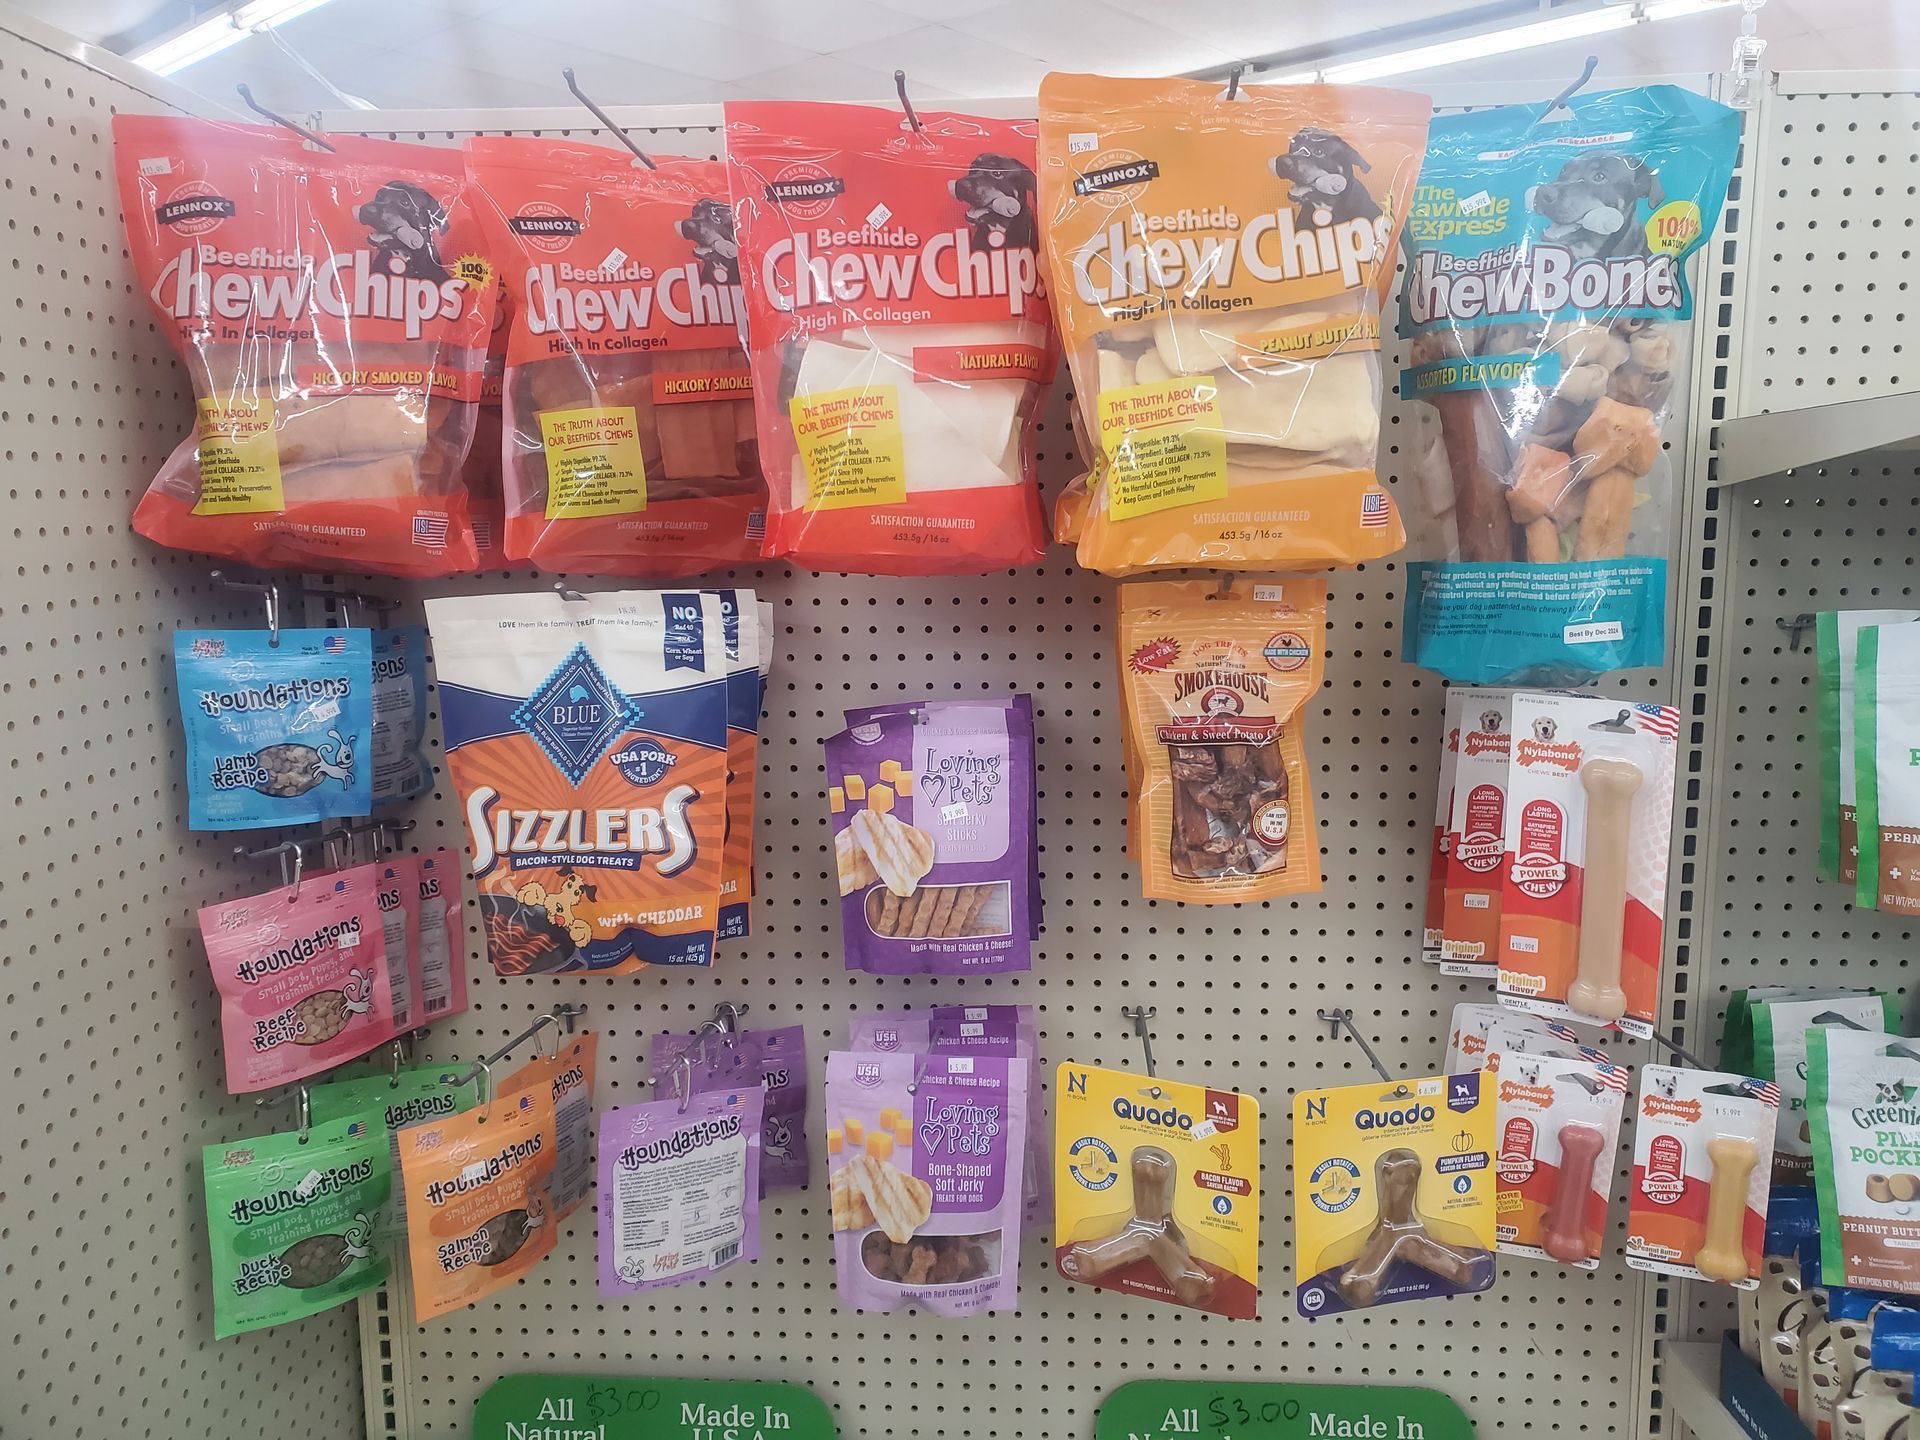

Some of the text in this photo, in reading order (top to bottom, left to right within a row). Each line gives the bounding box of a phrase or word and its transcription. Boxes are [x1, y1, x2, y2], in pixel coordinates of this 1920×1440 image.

[1069, 141, 1091, 152] $15.99
[776, 182, 835, 197] LENNOX
[1418, 185, 1456, 201] The
[519, 221, 573, 231] LENNOX
[1132, 205, 1240, 235] Beefhide
[1409, 215, 1507, 241] Express
[816, 226, 920, 248] Beefhide
[201, 244, 315, 269] Beefhide
[1073, 208, 1393, 307] Chew Chips
[762, 232, 918, 312] Chew
[151, 248, 469, 340] Chew Chips
[1113, 295, 1253, 321] High In Collagen
[549, 336, 668, 353] High In Collagen
[1259, 322, 1364, 353] PEANUT BUTTER
[803, 396, 884, 419] THE TRUTH ABOUT
[553, 417, 624, 433] THE TRUTH ABOUT
[1169, 466, 1180, 474] 1990
[1122, 486, 1130, 494] No
[1130, 482, 1151, 492] Harmful
[1153, 477, 1176, 488] Chemicals
[1183, 471, 1216, 482] Preservatives
[870, 514, 975, 529] SATISFACTION GUARANTEED
[1193, 510, 1310, 524] SATISFACTION GUARANTEED
[253, 521, 367, 537] SATISFACTION GUARANTEED
[617, 521, 708, 530] SATISFACTION GUARANTEED
[672, 607, 698, 620] NO
[1137, 644, 1173, 666] Low Fat
[1174, 670, 1270, 703] SMOKEHOUSE
[201, 677, 351, 716] Houndations
[552, 704, 601, 726] BLUE
[1191, 729, 1199, 741] &
[1202, 730, 1231, 741] Sweet
[1234, 729, 1264, 742] Potato
[1471, 737, 1510, 749] Nylabon
[610, 750, 677, 765] USA PORK
[1523, 746, 1575, 760] Nylabone
[215, 753, 257, 771] Lamb
[925, 747, 1001, 783] Loving
[212, 768, 268, 789] Recipe
[948, 774, 993, 805] Pets
[1527, 810, 1557, 819] LASTING
[465, 784, 701, 880] SIZZLERS
[947, 828, 977, 841] Sticks
[1464, 844, 1499, 856] POWER
[516, 855, 634, 867] BACON-STYLE DOG TREATS
[1467, 856, 1497, 868] CHEW
[1520, 870, 1558, 878] POWER
[1524, 881, 1557, 892] CHEW
[598, 905, 703, 928] with CHEDDAR
[236, 915, 362, 983] Houndations
[1445, 943, 1482, 955] Original
[1500, 973, 1543, 989] Original
[1509, 984, 1535, 995] flavor
[1505, 999, 1528, 1007] GENTLE
[255, 1009, 296, 1035] Beef
[1618, 1020, 1647, 1032] EXTREME
[253, 1020, 305, 1051] Recipe
[875, 1032, 898, 1043] USA
[857, 1066, 880, 1076] USA
[922, 1076, 1001, 1088] Chicken & Cheese Recipe
[1505, 1085, 1549, 1100] Nylabone
[1113, 1098, 1192, 1130] Quado
[1649, 1100, 1695, 1114] Nylabone
[924, 1096, 1000, 1137] Loving
[1355, 1105, 1435, 1130] Quado
[1509, 1124, 1531, 1132] LASTING
[620, 1114, 741, 1172] Houndations
[946, 1122, 991, 1155] Pets
[1655, 1142, 1678, 1150] LASTING
[1441, 1154, 1484, 1166] PUMPKIN FLAVOR
[1501, 1163, 1529, 1171] POWER
[928, 1162, 992, 1178] Bone-Shaped
[1503, 1172, 1527, 1180] CHEW
[935, 1177, 984, 1194] Soft Jerky
[1201, 1173, 1244, 1187] BACON FLAVOR
[1648, 1183, 1678, 1191] POWER
[936, 1194, 983, 1203] TREATS FOR DOGS
[1651, 1193, 1677, 1201] CHEW
[1496, 1226, 1517, 1236] acon
[1843, 1223, 1920, 1237] PEANUT BUTT
[437, 1228, 489, 1260] Salmon
[1638, 1245, 1680, 1258] Peanut Butter
[240, 1254, 280, 1278] Duck
[440, 1241, 491, 1275] Recipe
[234, 1264, 292, 1295] Recipe
[1307, 1296, 1321, 1304] USA
[537, 1398, 575, 1422] All
[680, 1402, 790, 1429] Made In
[1208, 1391, 1300, 1433] $3.00
[1731, 1395, 1750, 1422] Made
[1759, 1426, 1768, 1440] US
[1160, 1408, 1200, 1432] All
[1309, 1412, 1424, 1439] Made In
